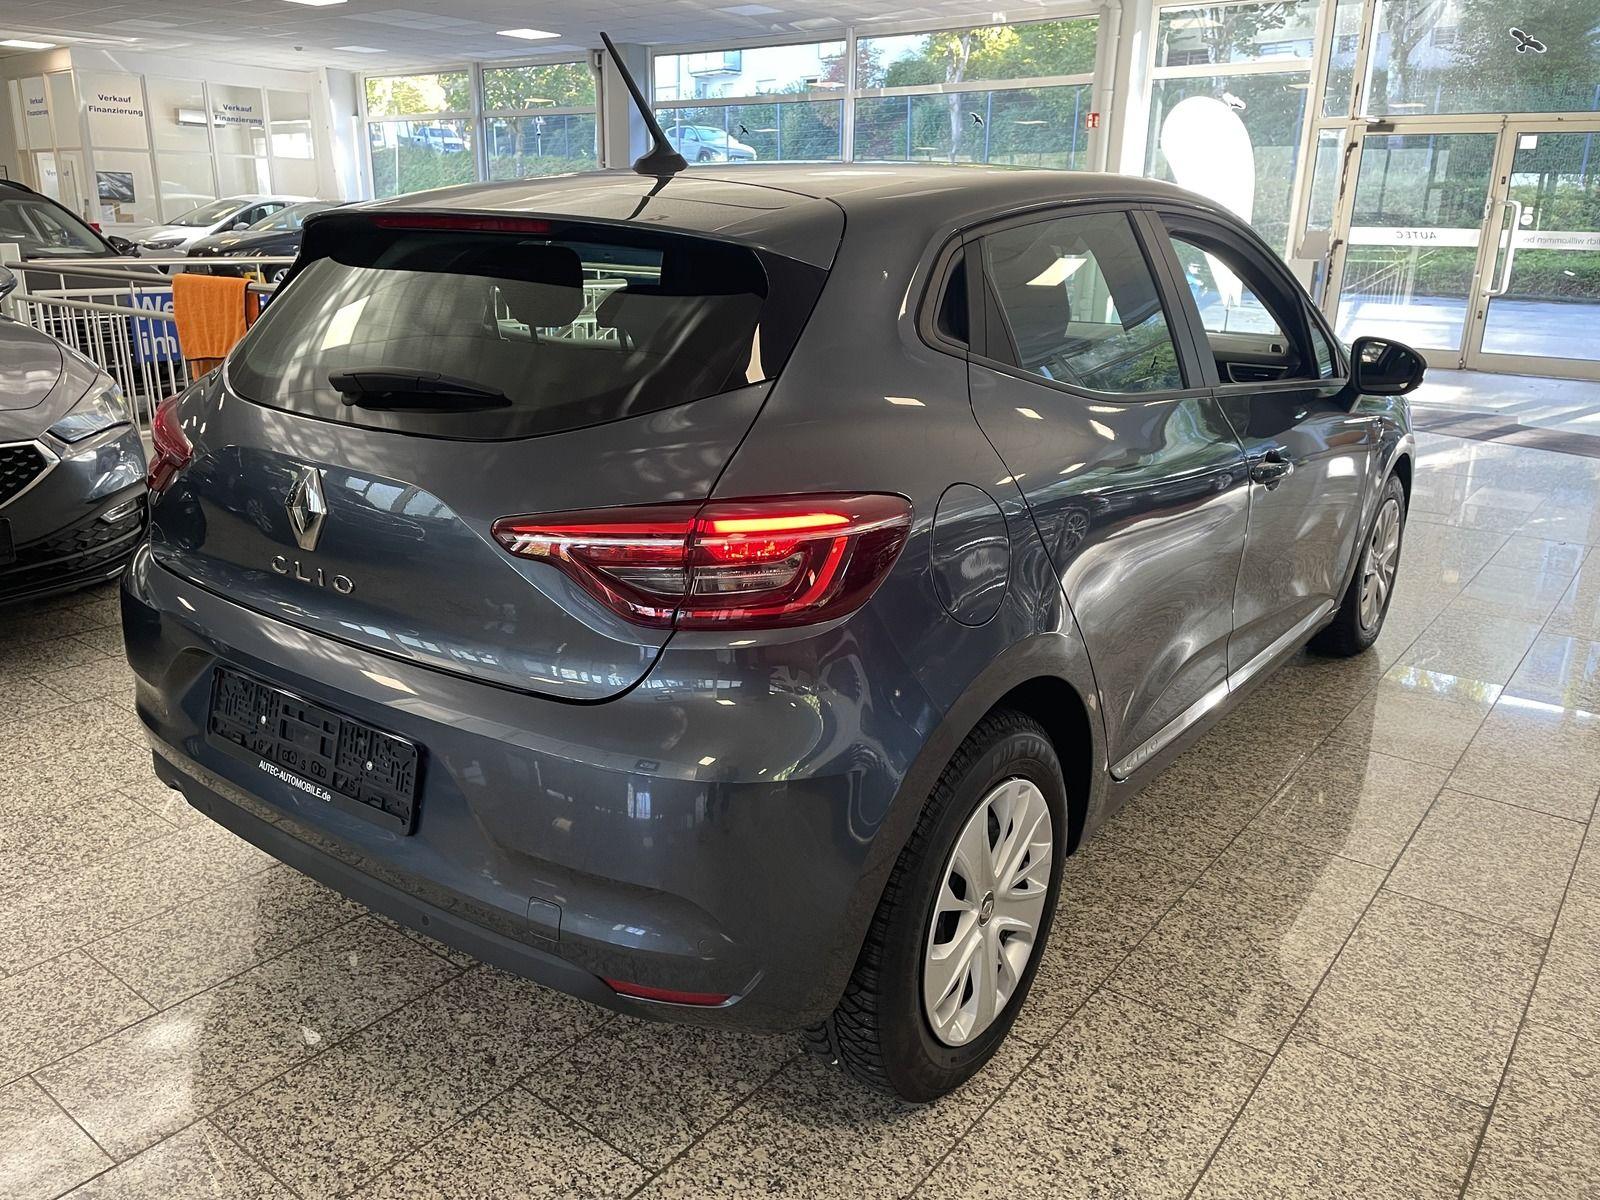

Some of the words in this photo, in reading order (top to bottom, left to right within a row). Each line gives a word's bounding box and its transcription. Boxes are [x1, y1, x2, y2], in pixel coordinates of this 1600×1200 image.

[98, 94, 131, 103] Verkauf
[88, 105, 144, 117] Finanzierung
[223, 103, 252, 112] Verkauf
[214, 114, 263, 126] Finanzierung
[134, 296, 174, 320] We
[272, 555, 355, 595] CLIO
[258, 759, 332, 802] AUTEC-AUTOMOBILE.de
